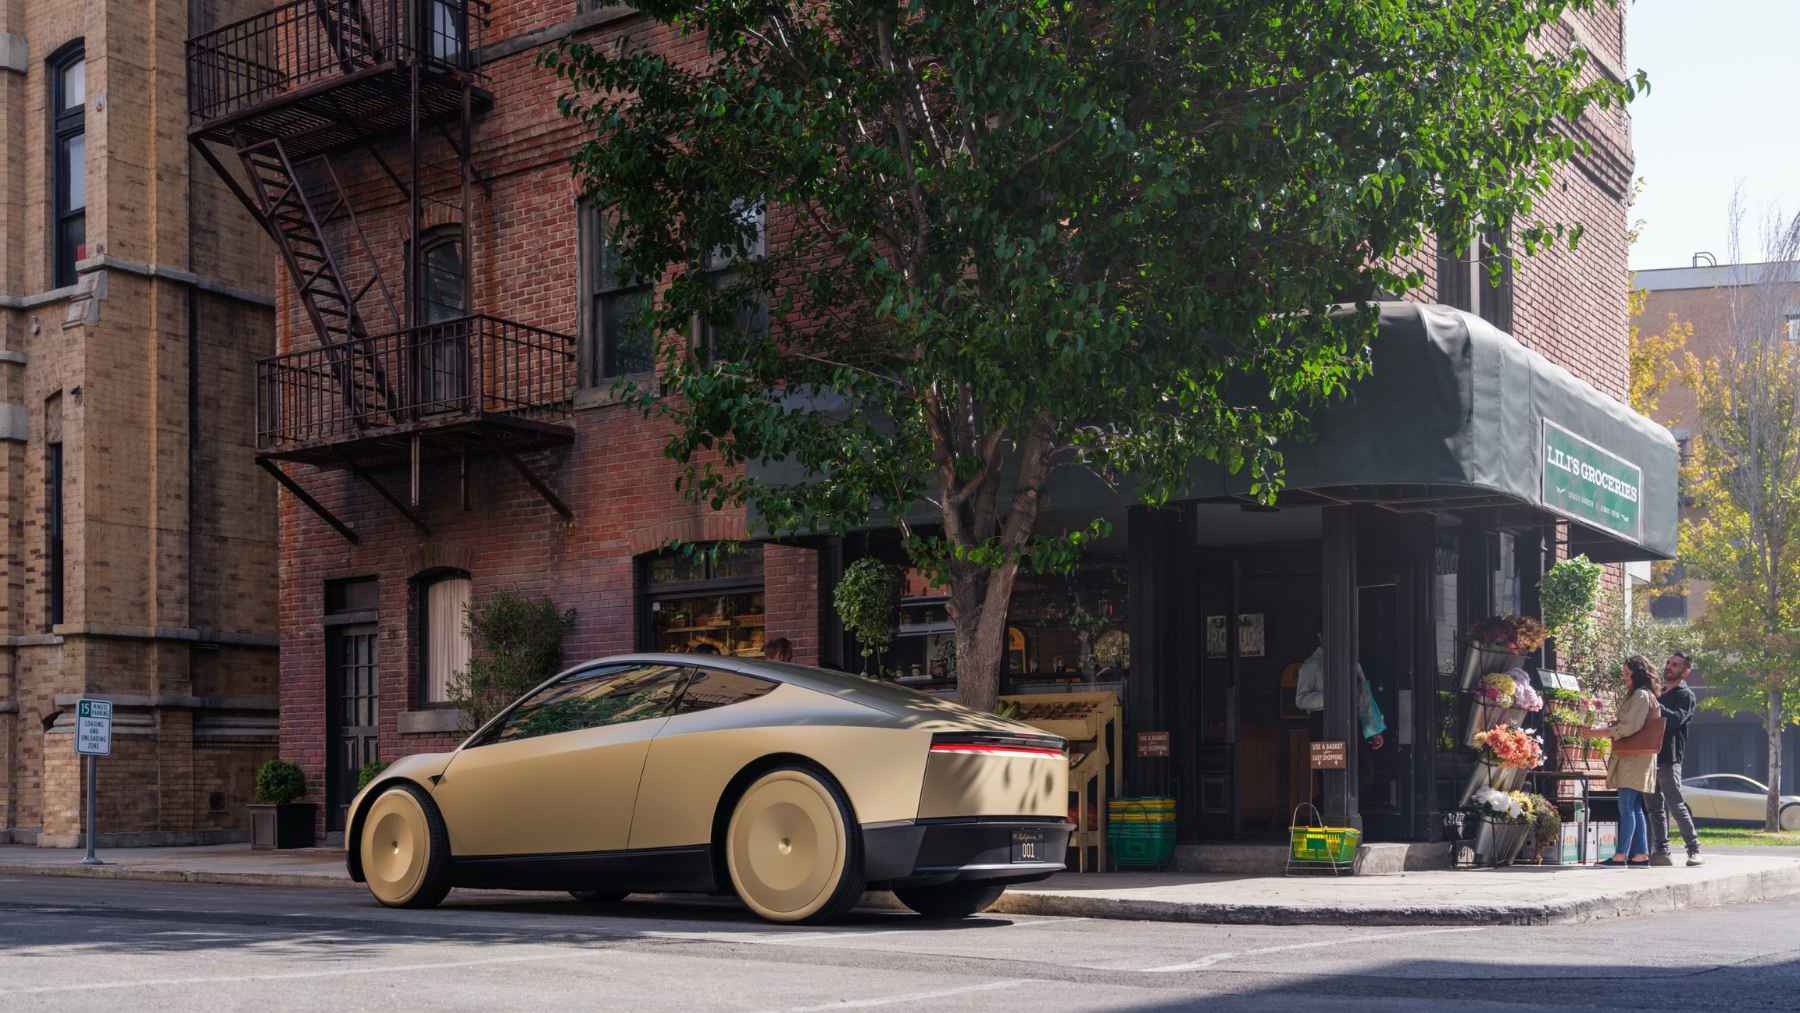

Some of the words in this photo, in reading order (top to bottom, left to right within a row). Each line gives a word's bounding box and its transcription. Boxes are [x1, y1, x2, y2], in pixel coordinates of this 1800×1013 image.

[1547, 445, 1580, 476] LILI'S
[1581, 462, 1637, 502] GROCERIES
[81, 702, 90, 715] 15
[1022, 843, 1035, 858] 001
